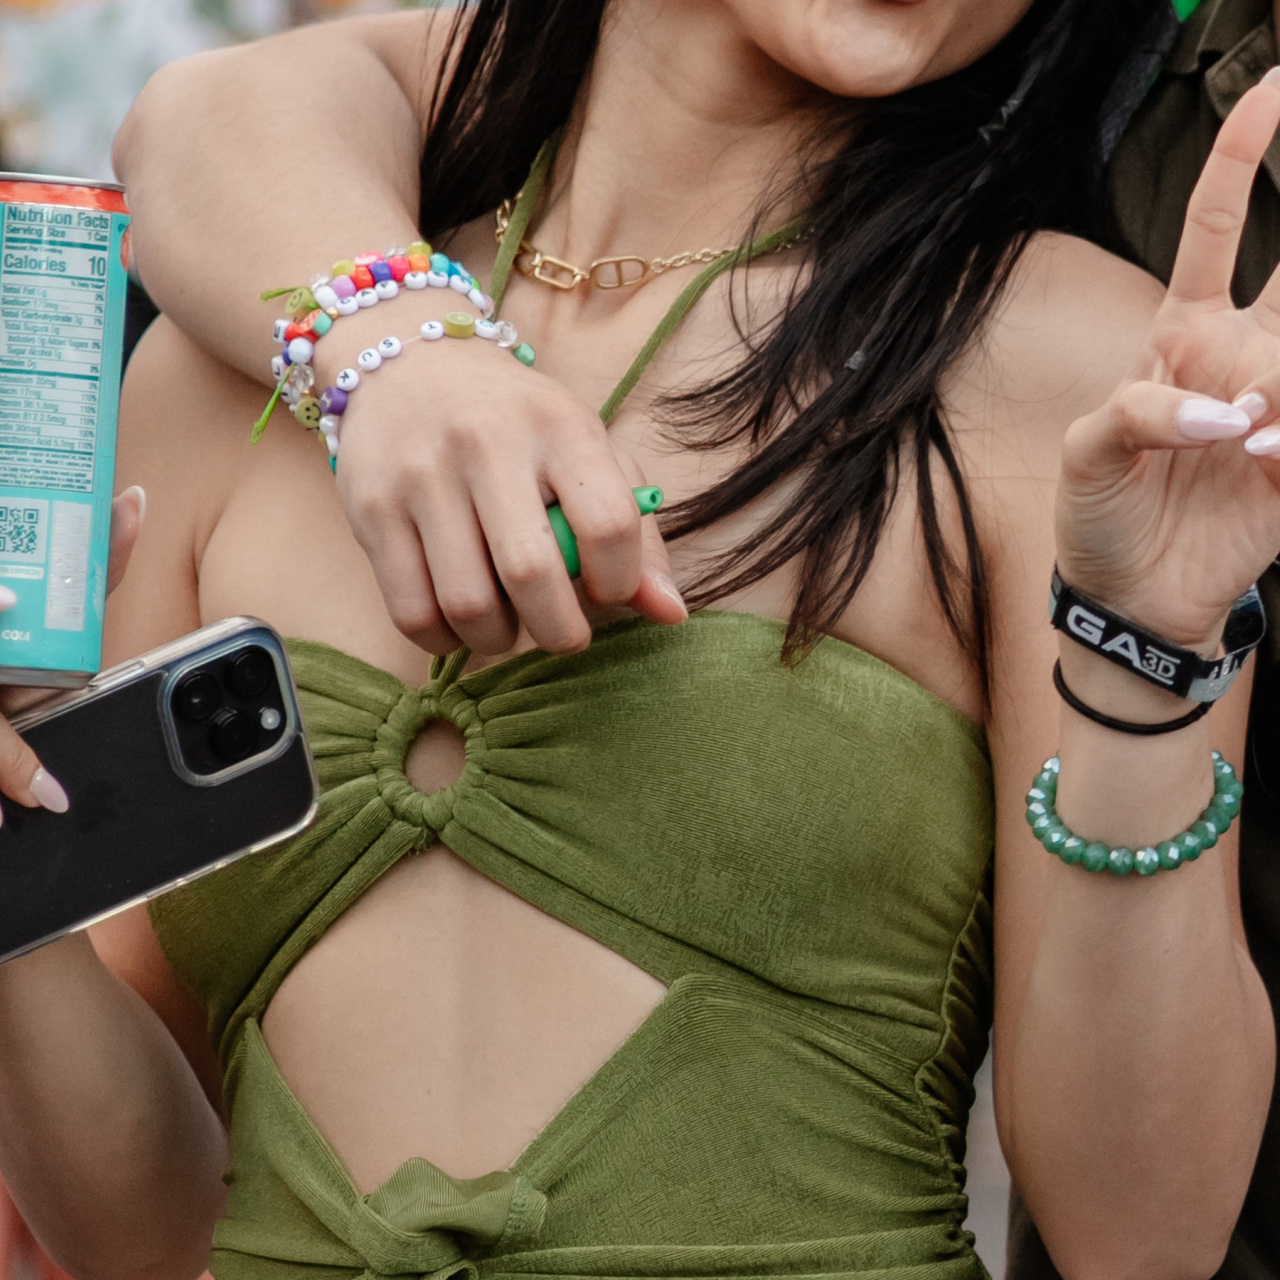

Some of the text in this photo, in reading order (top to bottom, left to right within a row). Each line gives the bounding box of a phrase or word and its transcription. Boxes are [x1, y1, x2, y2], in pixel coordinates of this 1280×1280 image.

[7, 206, 109, 229] Nutrition Facts
[6, 224, 43, 237] Serving
[47, 227, 66, 238] Size
[94, 232, 108, 242] Can
[4, 253, 106, 276] Calories 10
[3, 285, 20, 294] Total
[23, 287, 35, 295] Fat
[2, 297, 30, 306] Sodium
[2, 309, 19, 318] Total
[21, 310, 72, 322] Carbohydrate
[23, 323, 49, 334] Sugars
